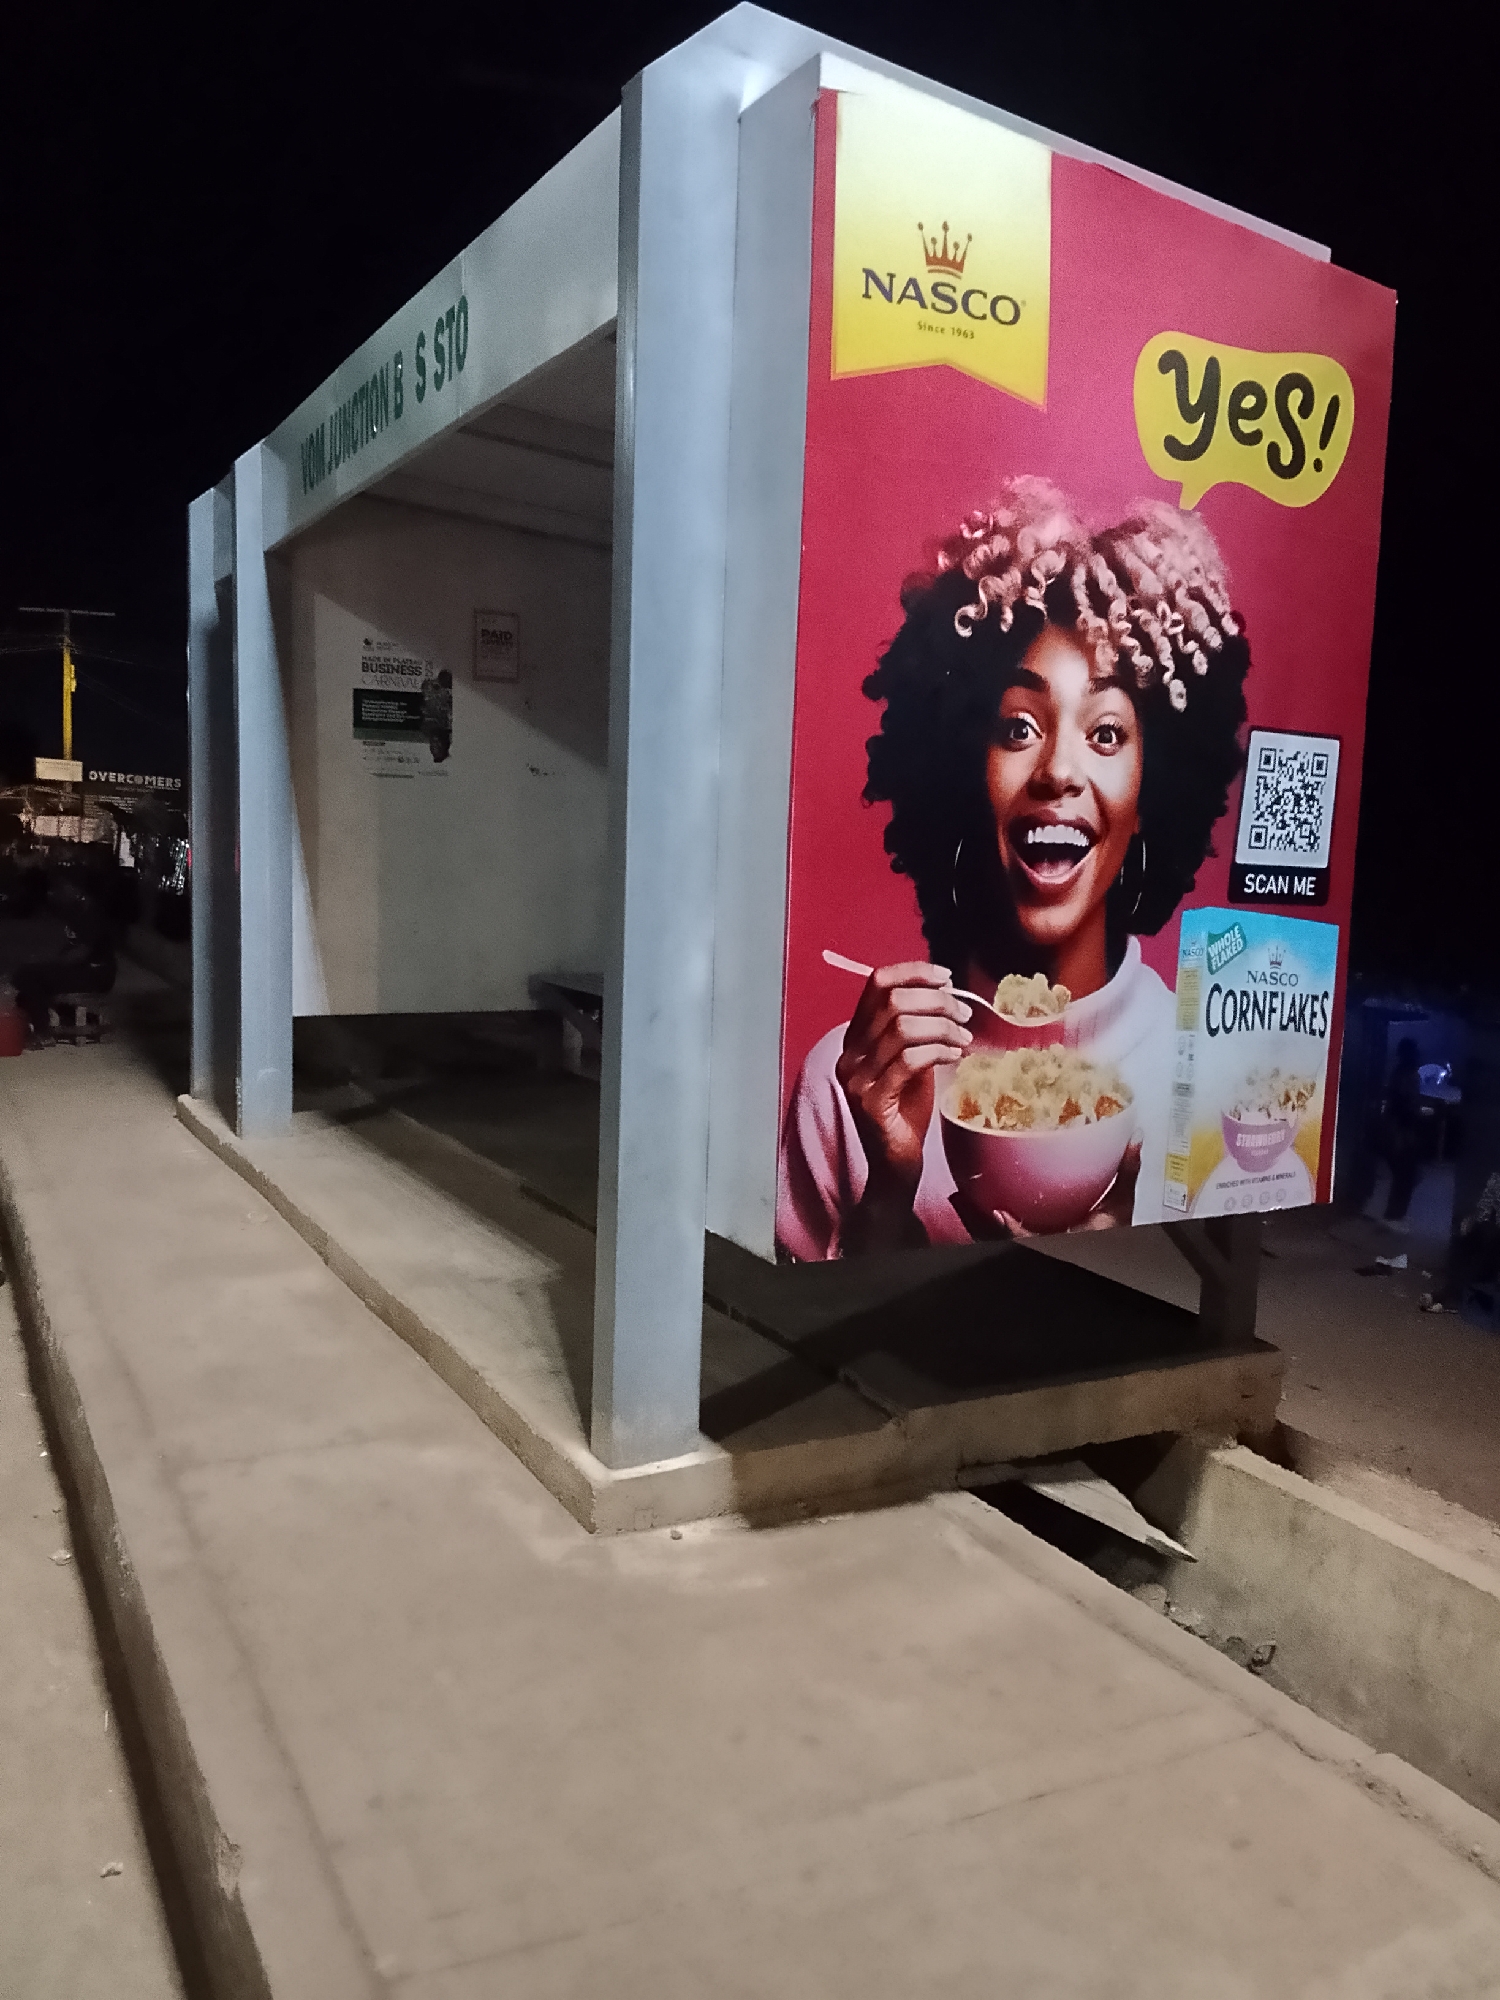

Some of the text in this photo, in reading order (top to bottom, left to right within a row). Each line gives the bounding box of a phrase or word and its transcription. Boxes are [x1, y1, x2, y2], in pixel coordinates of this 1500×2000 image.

[862, 267, 1021, 326] NASCO
[917, 320, 975, 340] Since 1963
[327, 361, 389, 475] JUNCTION
[361, 661, 423, 677] BUSINESS
[88, 770, 182, 789] OVERCOMERS
[1243, 873, 1317, 896] SCAN ME
[1208, 925, 1241, 958] WHOLE
[1211, 938, 1244, 971] FLAKED
[1247, 970, 1299, 987] NASCO
[1206, 983, 1329, 1039] CORNFLAKES
